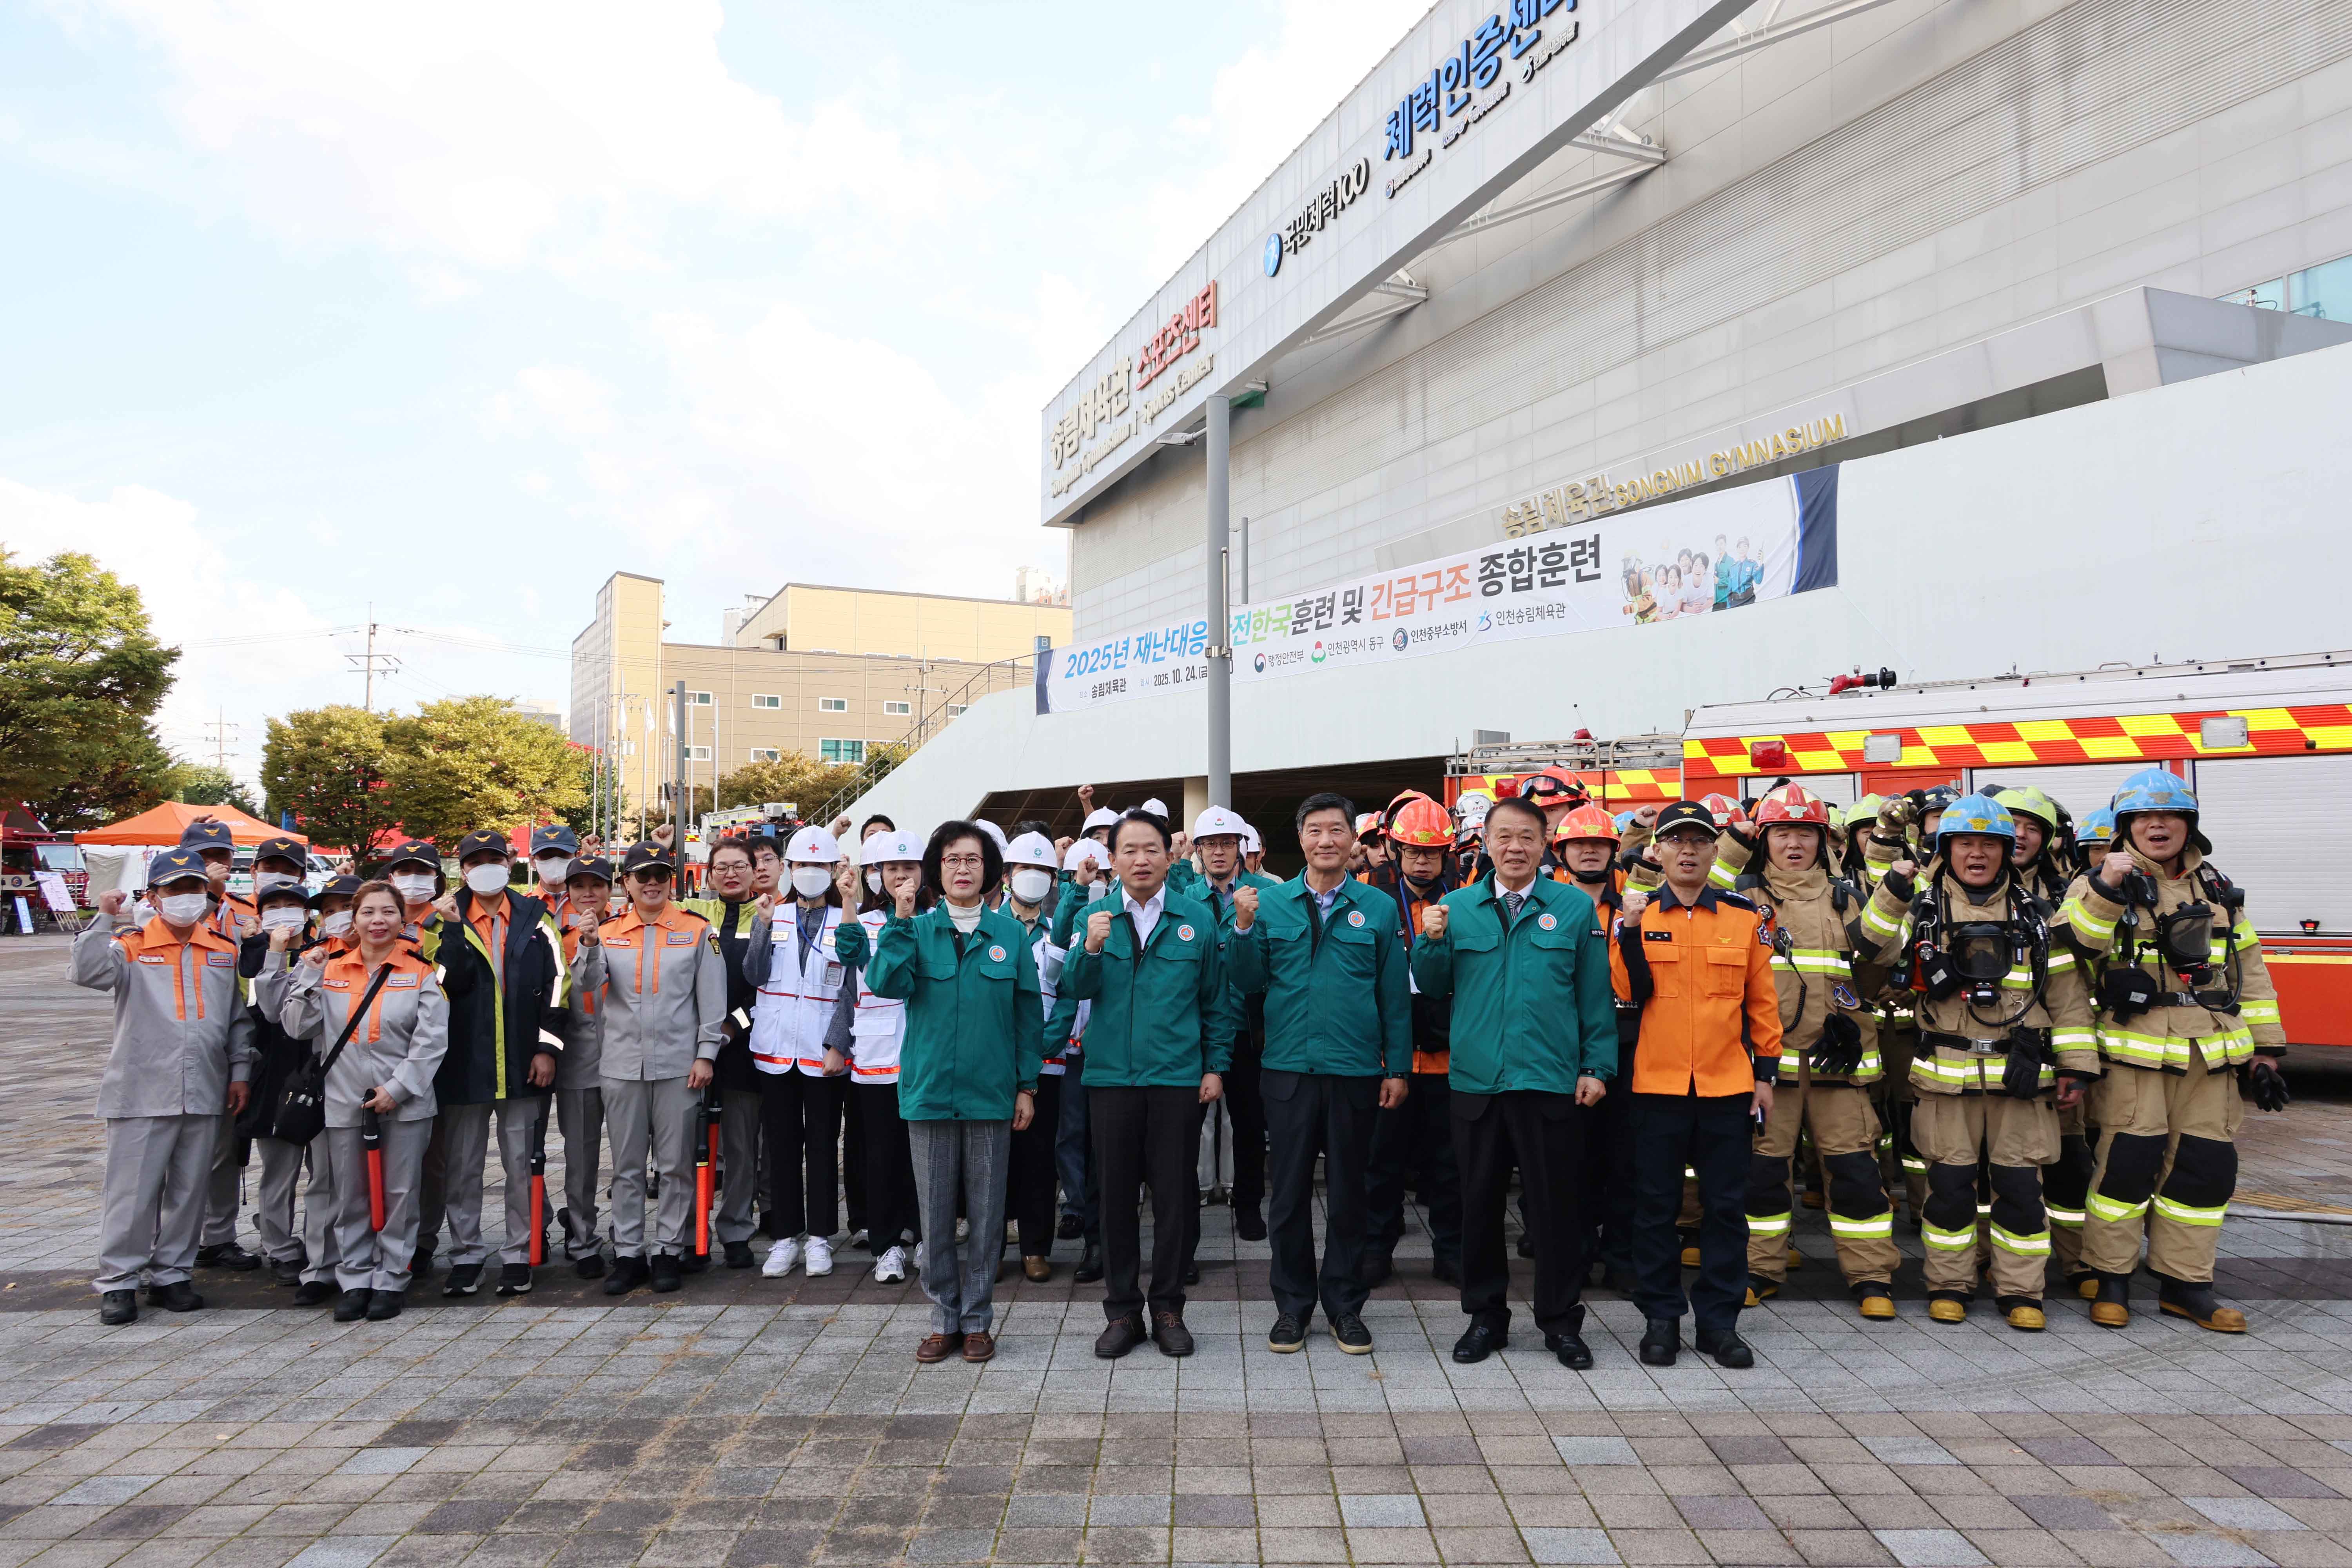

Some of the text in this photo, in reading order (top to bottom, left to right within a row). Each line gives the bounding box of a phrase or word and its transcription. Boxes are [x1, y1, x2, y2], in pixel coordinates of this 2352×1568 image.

[1384, 0, 1577, 161] 체력인증센
[1051, 279, 1217, 470] 송림체육관 스포츠센터
[1142, 384, 1175, 426] Sports
[1177, 353, 1213, 396] Center
[1501, 413, 1848, 540] 송림체육관 SONGNIM GYMNASIUM
[1064, 533, 1601, 679] 2025년 재난대응 전한국훈련 및 긴급구조 종합훈련
[1496, 603, 1566, 626] 인천송림체육관
[1411, 619, 1467, 643] 인천중부소방서
[1268, 650, 1304, 667] 행정안전부
[1328, 636, 1384, 657] 인천광역시 동구
[1154, 673, 1170, 686] 2025.
[1172, 668, 1182, 684] 10.
[1186, 665, 1198, 681] 24.
[1091, 678, 1127, 699] 송림체육관
